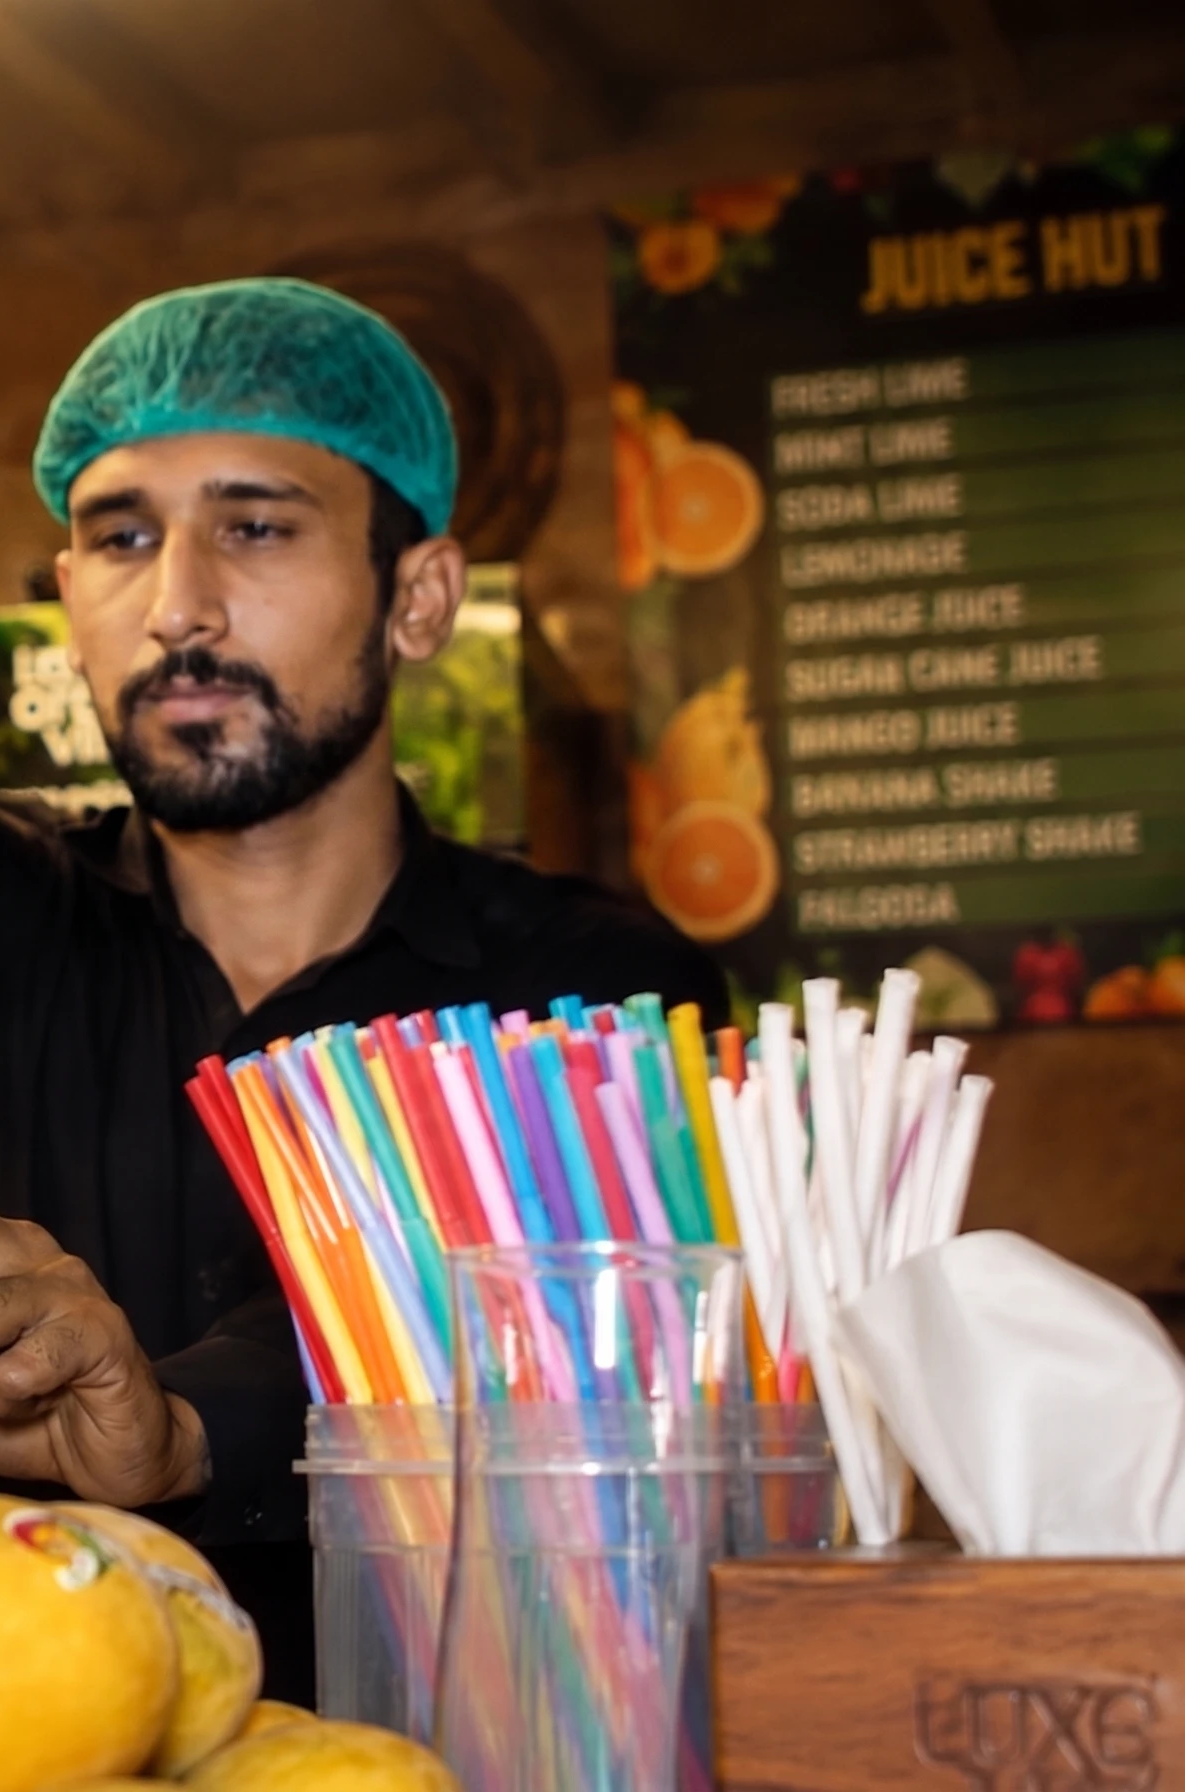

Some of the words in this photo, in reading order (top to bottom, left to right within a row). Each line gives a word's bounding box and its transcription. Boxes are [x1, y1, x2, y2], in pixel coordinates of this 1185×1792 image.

[864, 224, 1026, 311] JUICE
[1042, 210, 1163, 288] HUT
[772, 370, 877, 415] FRESH
[886, 358, 967, 405] LIME
[775, 428, 861, 472] MINT
[871, 419, 953, 464] LIME
[778, 486, 871, 531] SODA
[878, 475, 961, 520] LIME
[785, 594, 922, 643] ORANGE
[933, 585, 1022, 631] JUICE
[787, 655, 902, 700] SUGAR
[910, 647, 999, 690] CANE
[1011, 637, 1101, 682] JUICE
[790, 713, 918, 758] MANGO
[927, 704, 1018, 746] JUICE
[794, 770, 937, 815] BANANA
[945, 760, 1058, 805] SHAKE
[795, 821, 1018, 872] STRAWBERRY
[1026, 813, 1140, 859] SHAKE
